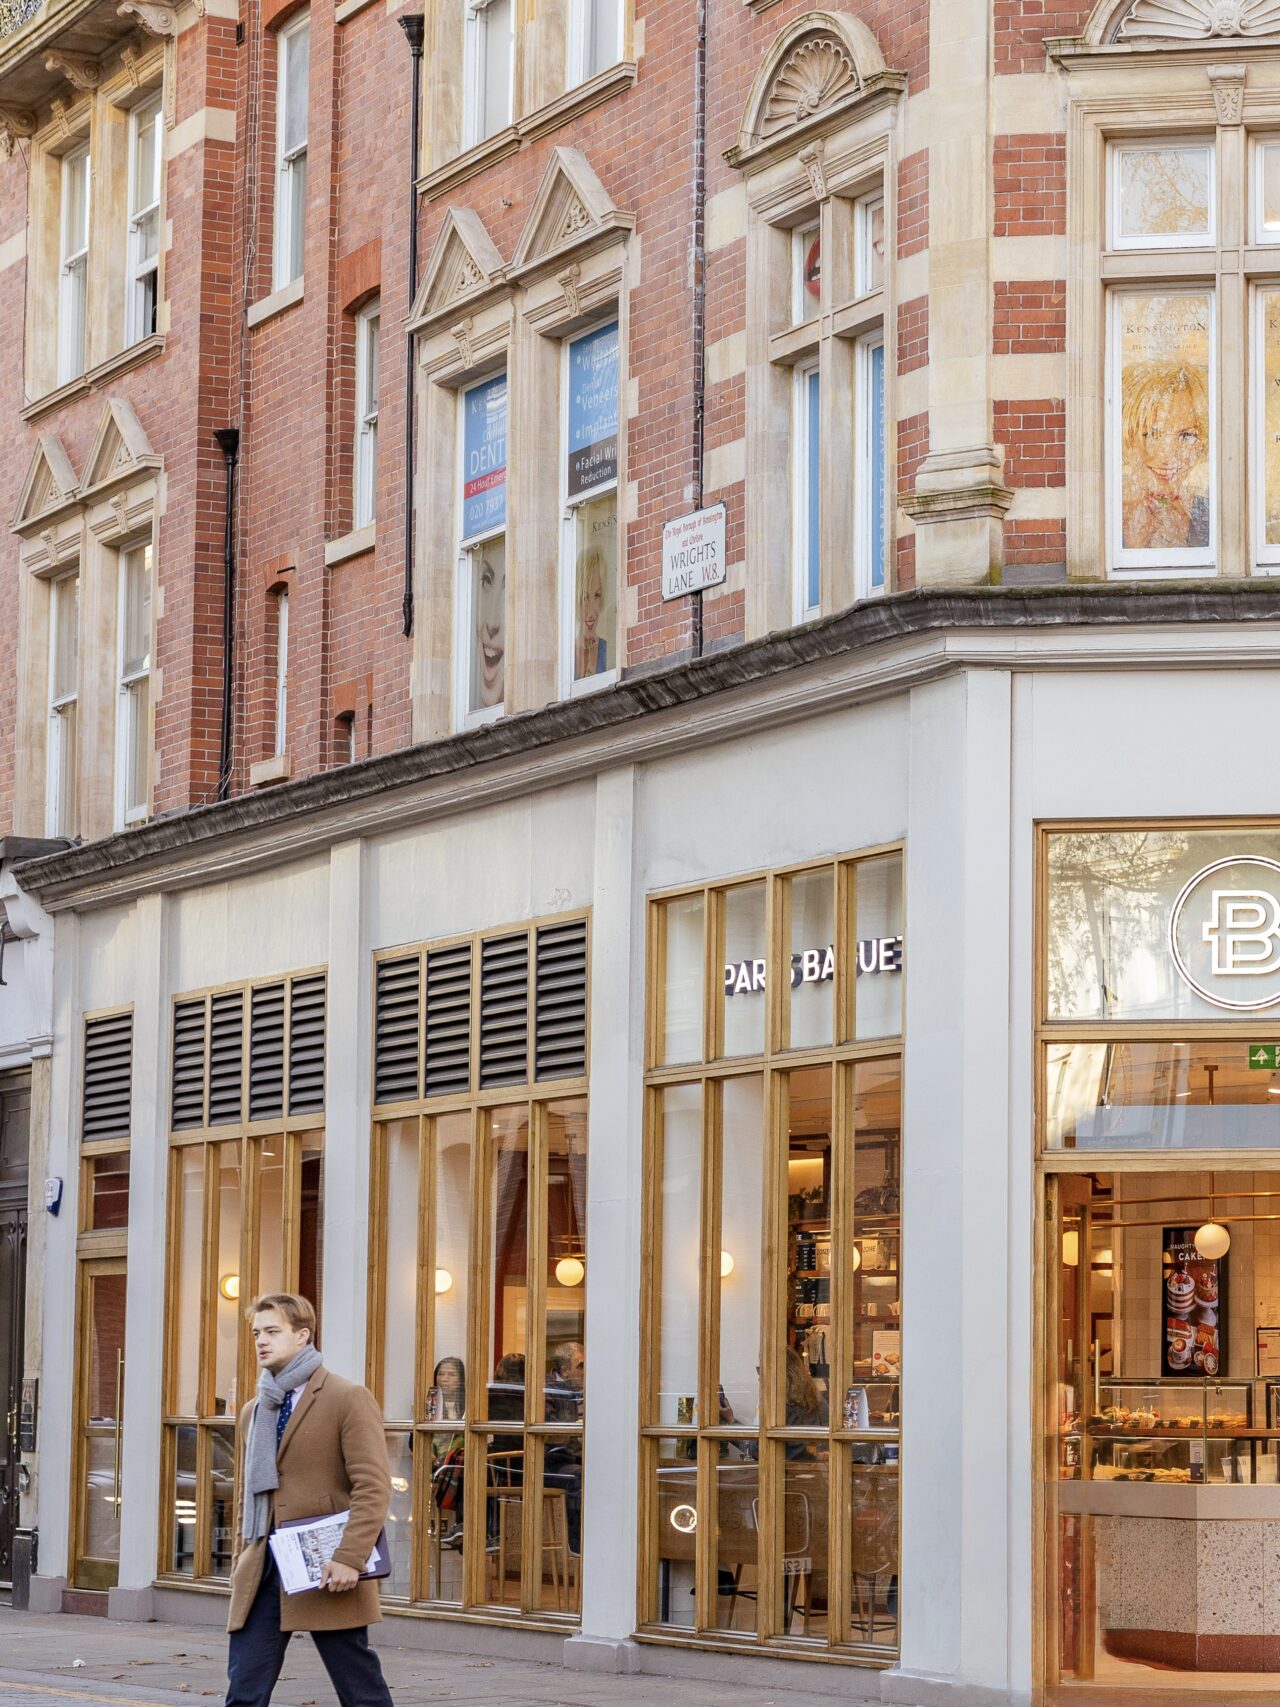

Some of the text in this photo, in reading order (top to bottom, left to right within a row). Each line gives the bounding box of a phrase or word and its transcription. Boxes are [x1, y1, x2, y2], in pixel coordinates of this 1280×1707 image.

[581, 385, 618, 410] Veneers
[580, 452, 604, 471] Facial
[580, 465, 612, 486] Reduction
[671, 540, 716, 570] WRIGHTS
[669, 562, 720, 594] LANE W.8.
[724, 954, 803, 996] PAR
[1170, 1243, 1196, 1251] NAUGHTY
[1178, 1252, 1207, 1261] CAKE
